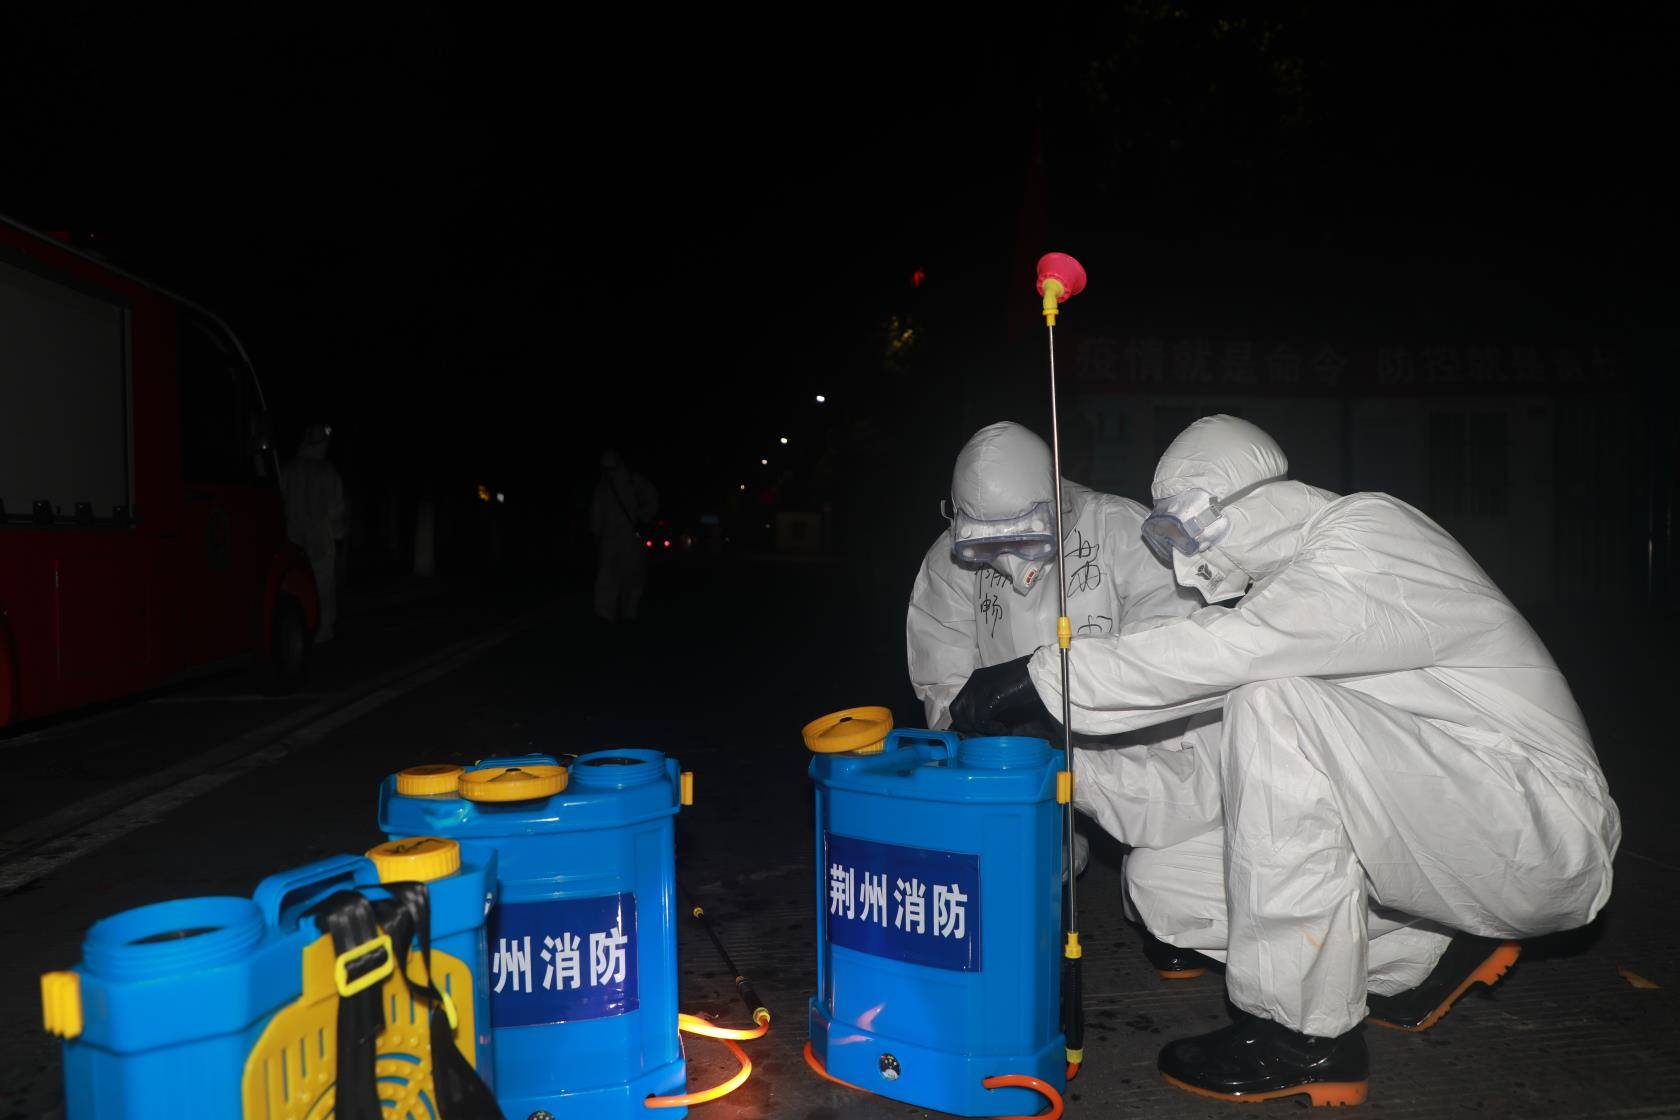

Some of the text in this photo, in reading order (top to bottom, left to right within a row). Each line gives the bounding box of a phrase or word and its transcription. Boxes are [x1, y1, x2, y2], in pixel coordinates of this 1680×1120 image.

[1074, 335, 1347, 386] 疫情就是命令
[829, 863, 968, 939] 荆州消防
[492, 926, 628, 994] 州消防
